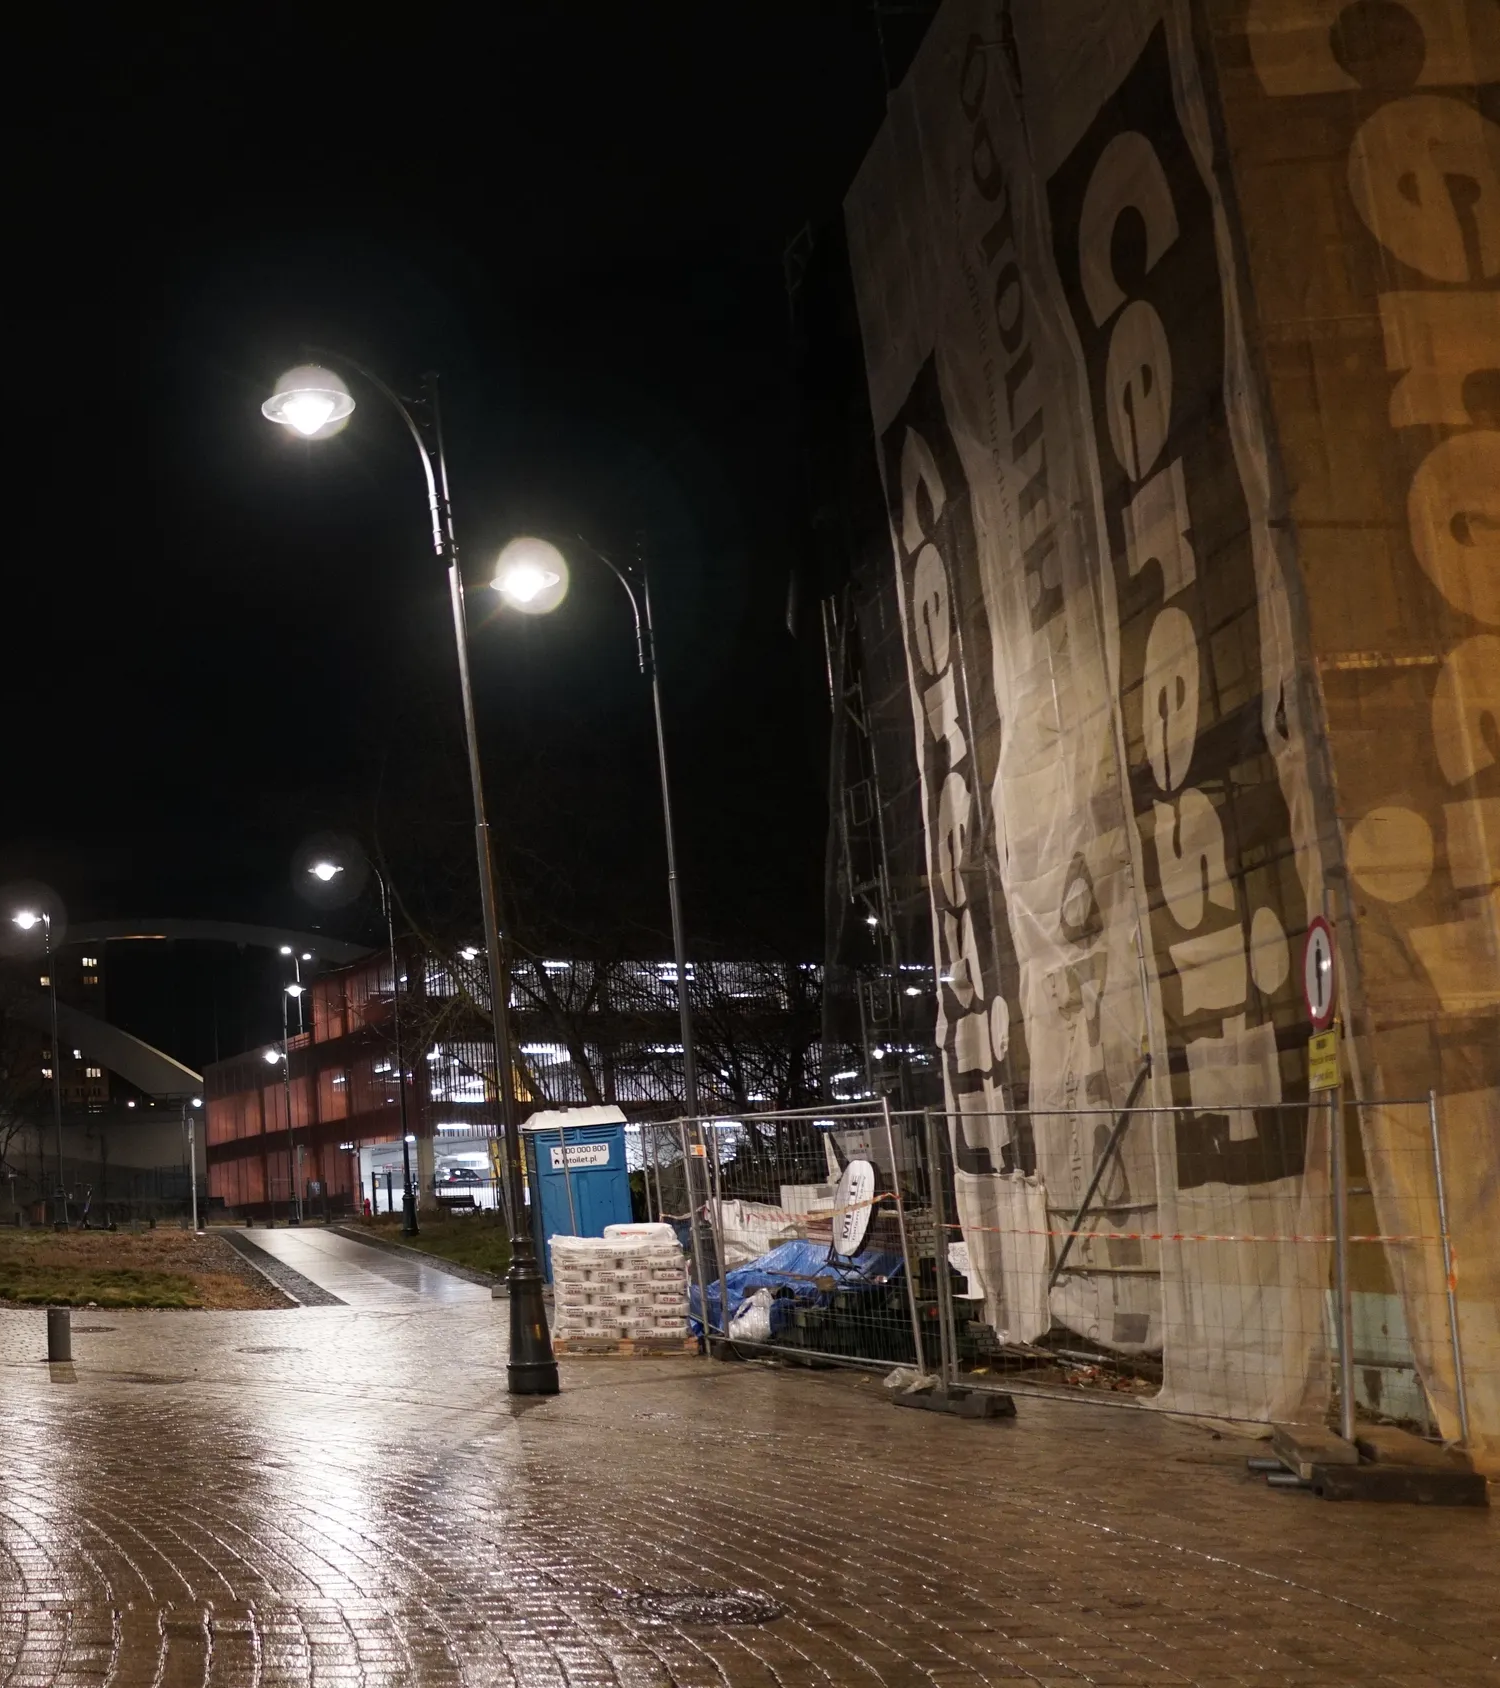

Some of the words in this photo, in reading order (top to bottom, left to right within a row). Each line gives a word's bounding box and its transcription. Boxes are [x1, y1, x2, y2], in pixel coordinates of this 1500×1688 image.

[900, 425, 1014, 1171] Ceresit
[1078, 130, 1289, 1142] Ceresit
[576, 1146, 591, 1154] 000
